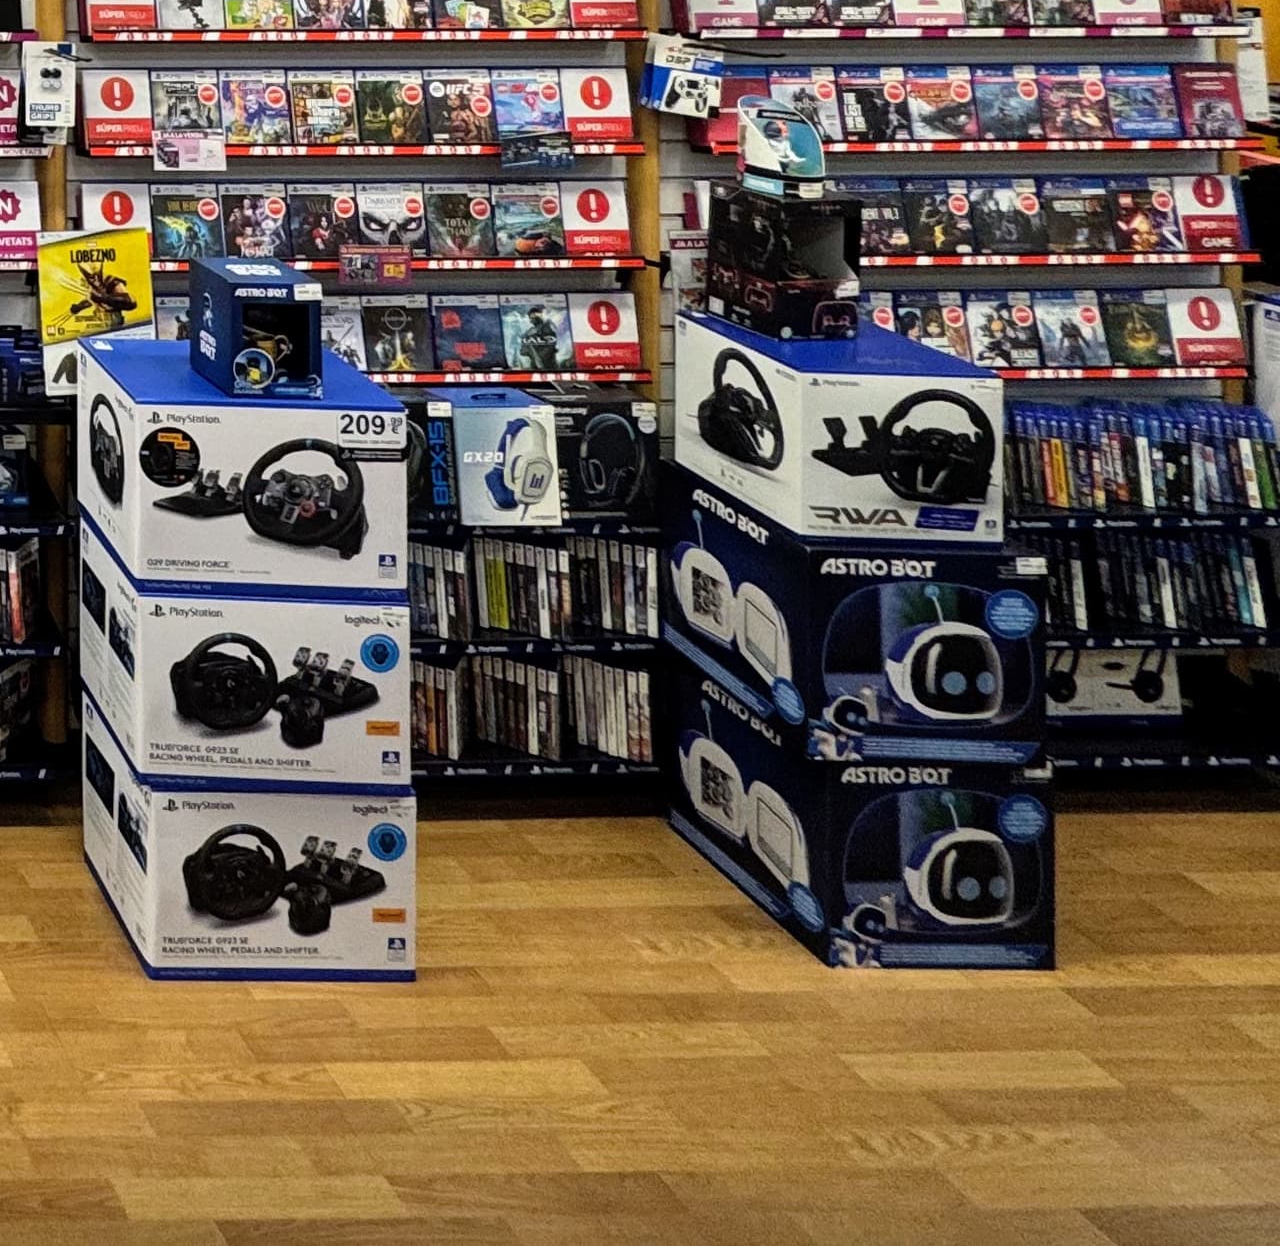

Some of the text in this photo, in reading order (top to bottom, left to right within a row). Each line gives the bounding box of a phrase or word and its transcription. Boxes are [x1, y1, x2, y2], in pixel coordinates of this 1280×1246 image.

[445, 82, 485, 96] UFC 5
[1202, 238, 1235, 248] GAME
[70, 249, 116, 263] LOBEZNO
[166, 413, 221, 425] PlayStation
[692, 488, 770, 545] ASTRO BOT
[147, 559, 230, 569] G29 DRIVING FORCE
[820, 558, 937, 578] ASTRO BOT
[169, 607, 223, 619] PlayStation
[702, 679, 750, 721] ASTRO
[150, 743, 202, 754] TRUEFORCE
[205, 745, 228, 754] G923
[149, 753, 184, 762] RACING
[220, 756, 253, 765] PEDALS
[255, 757, 274, 766] AND
[276, 759, 311, 767] SHIFTER
[841, 766, 953, 786] ASTRO BOT
[162, 936, 213, 945] TRUEFORCE
[162, 945, 196, 955] RACING
[231, 947, 262, 956] PEDALS
[264, 947, 283, 956] AND
[285, 947, 319, 956] SHIFTER
